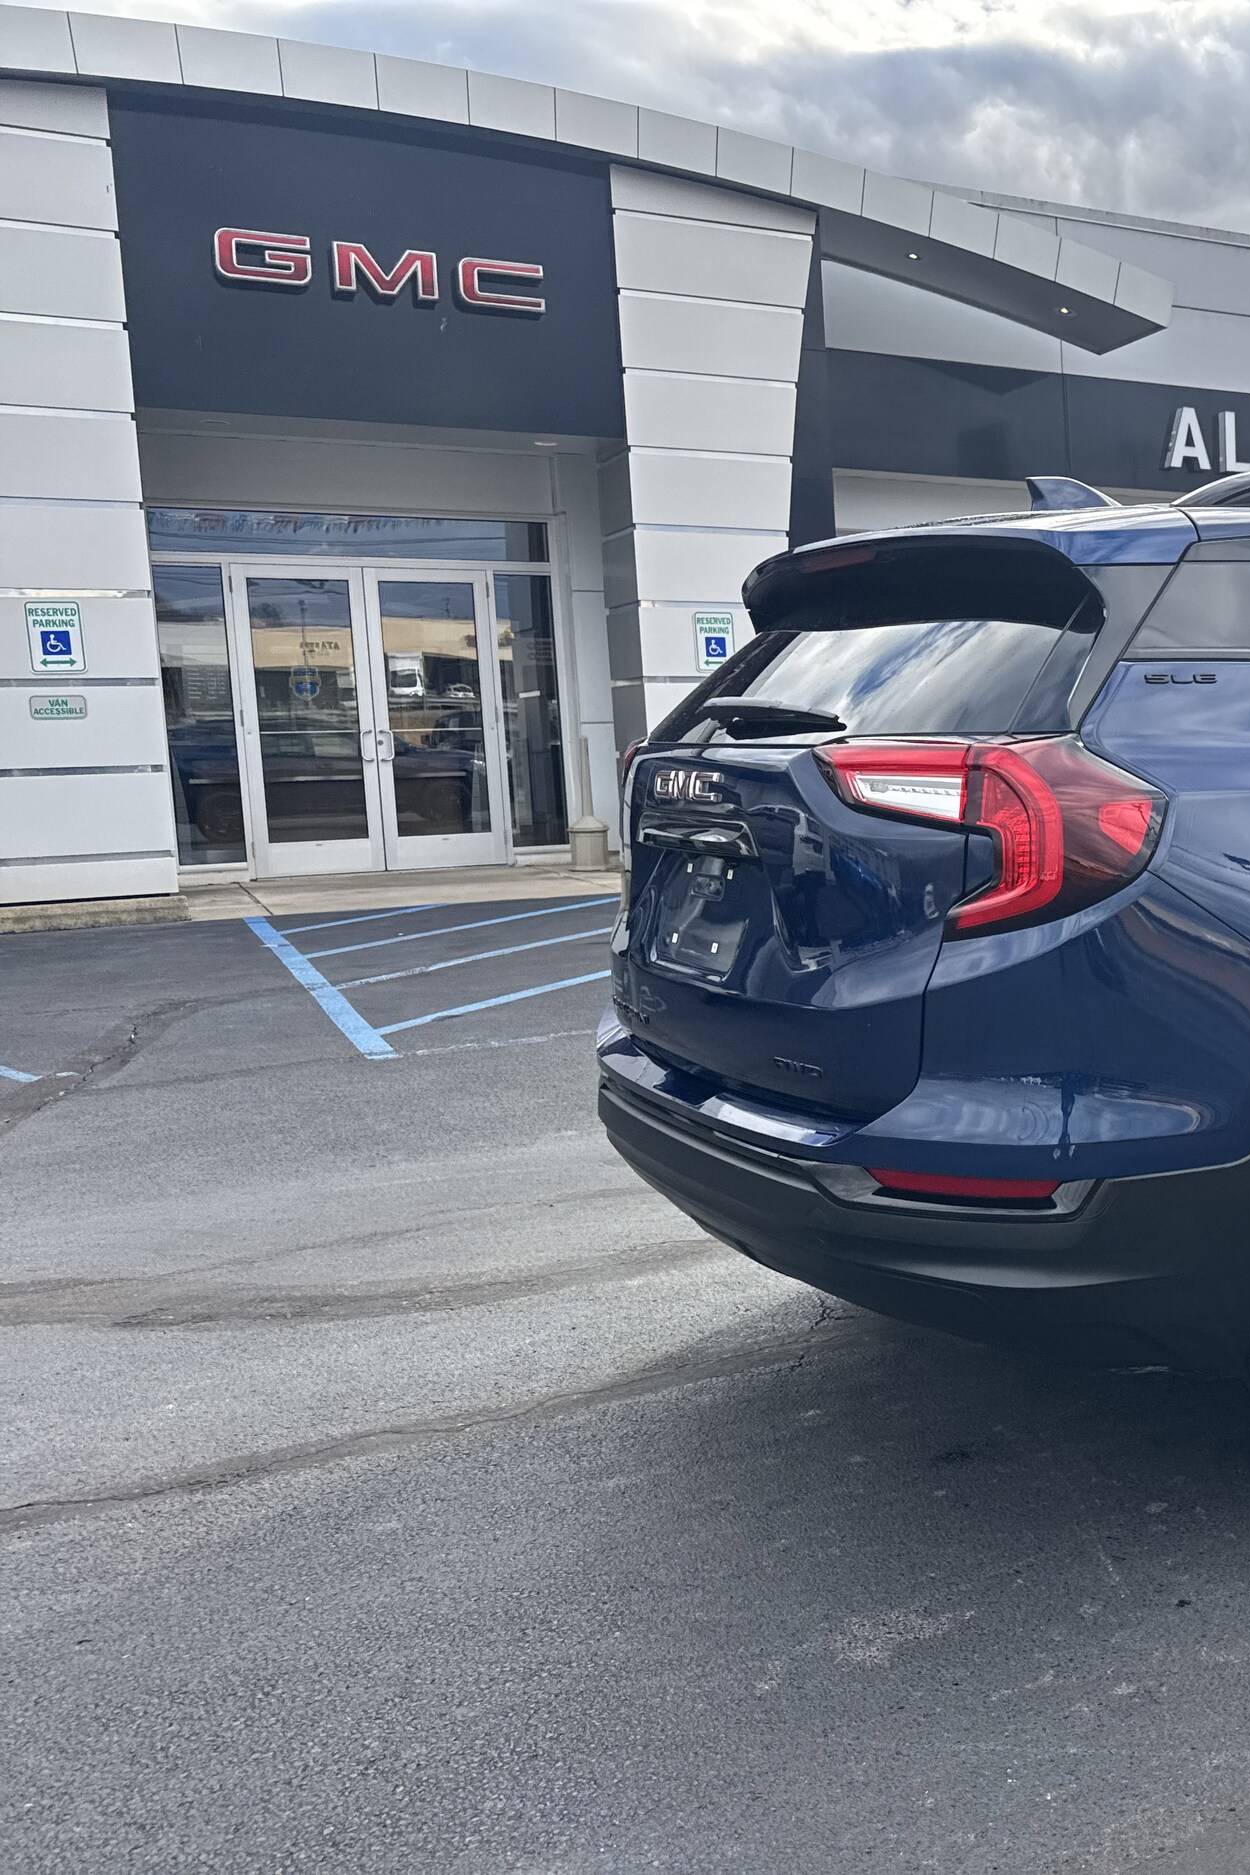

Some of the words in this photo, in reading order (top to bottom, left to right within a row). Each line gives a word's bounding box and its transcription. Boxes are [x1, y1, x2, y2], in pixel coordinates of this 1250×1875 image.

[214, 227, 546, 313] GMC
[27, 607, 77, 617] RESERVED
[32, 618, 76, 628] PARKING
[696, 616, 731, 625] RESERVED
[699, 626, 730, 635] PARKING
[48, 699, 69, 707] VAN
[33, 707, 85, 716] ACCESSIBLE
[654, 769, 725, 803] GMC
